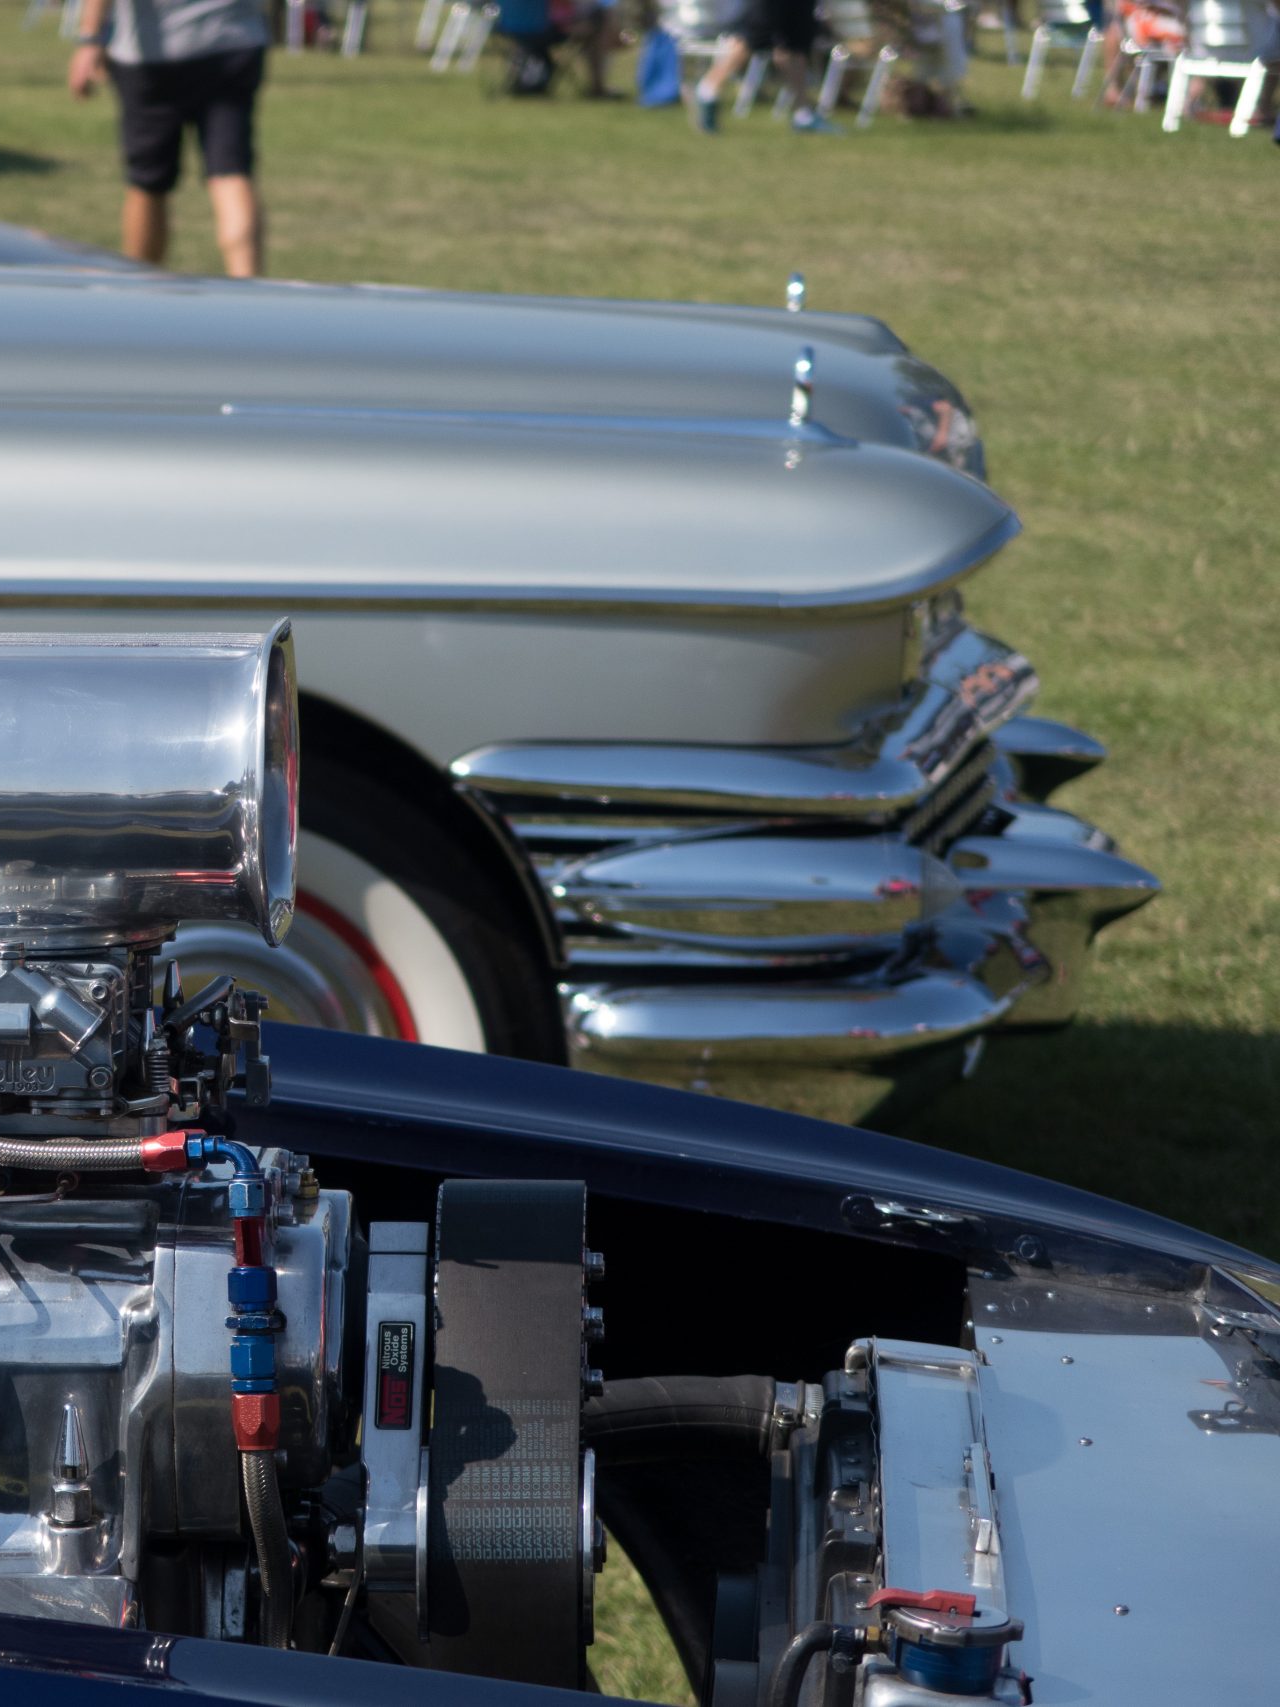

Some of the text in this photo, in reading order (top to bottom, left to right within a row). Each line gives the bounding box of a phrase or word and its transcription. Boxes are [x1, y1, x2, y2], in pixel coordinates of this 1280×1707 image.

[11, 1082, 39, 1092] 1903
[381, 1331, 392, 1369] Nitrous
[390, 1335, 400, 1366] Oxide
[398, 1328, 409, 1373] Systems
[380, 1375, 408, 1425] NOS
